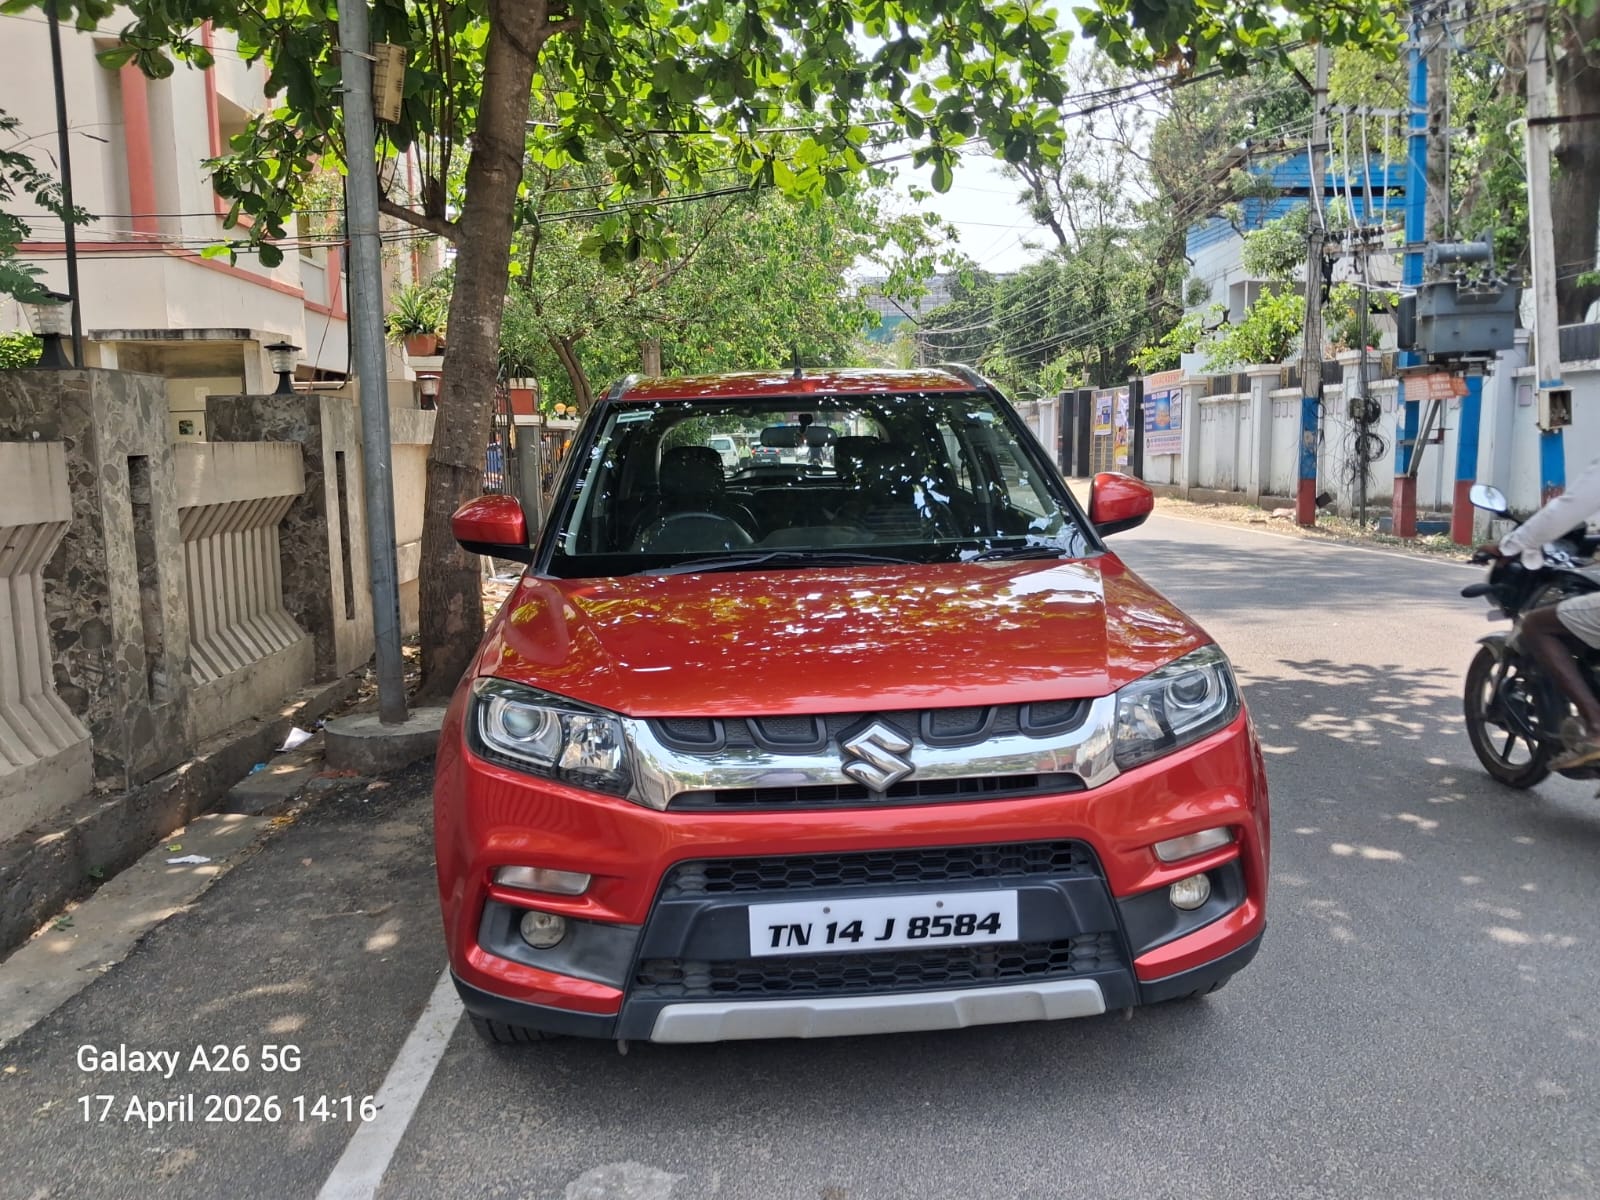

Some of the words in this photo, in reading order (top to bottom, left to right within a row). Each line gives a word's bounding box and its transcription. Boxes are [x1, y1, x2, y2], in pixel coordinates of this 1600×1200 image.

[768, 923, 813, 948] TN
[826, 919, 864, 945] 14
[874, 918, 896, 941] J
[906, 912, 1002, 940] 8584
